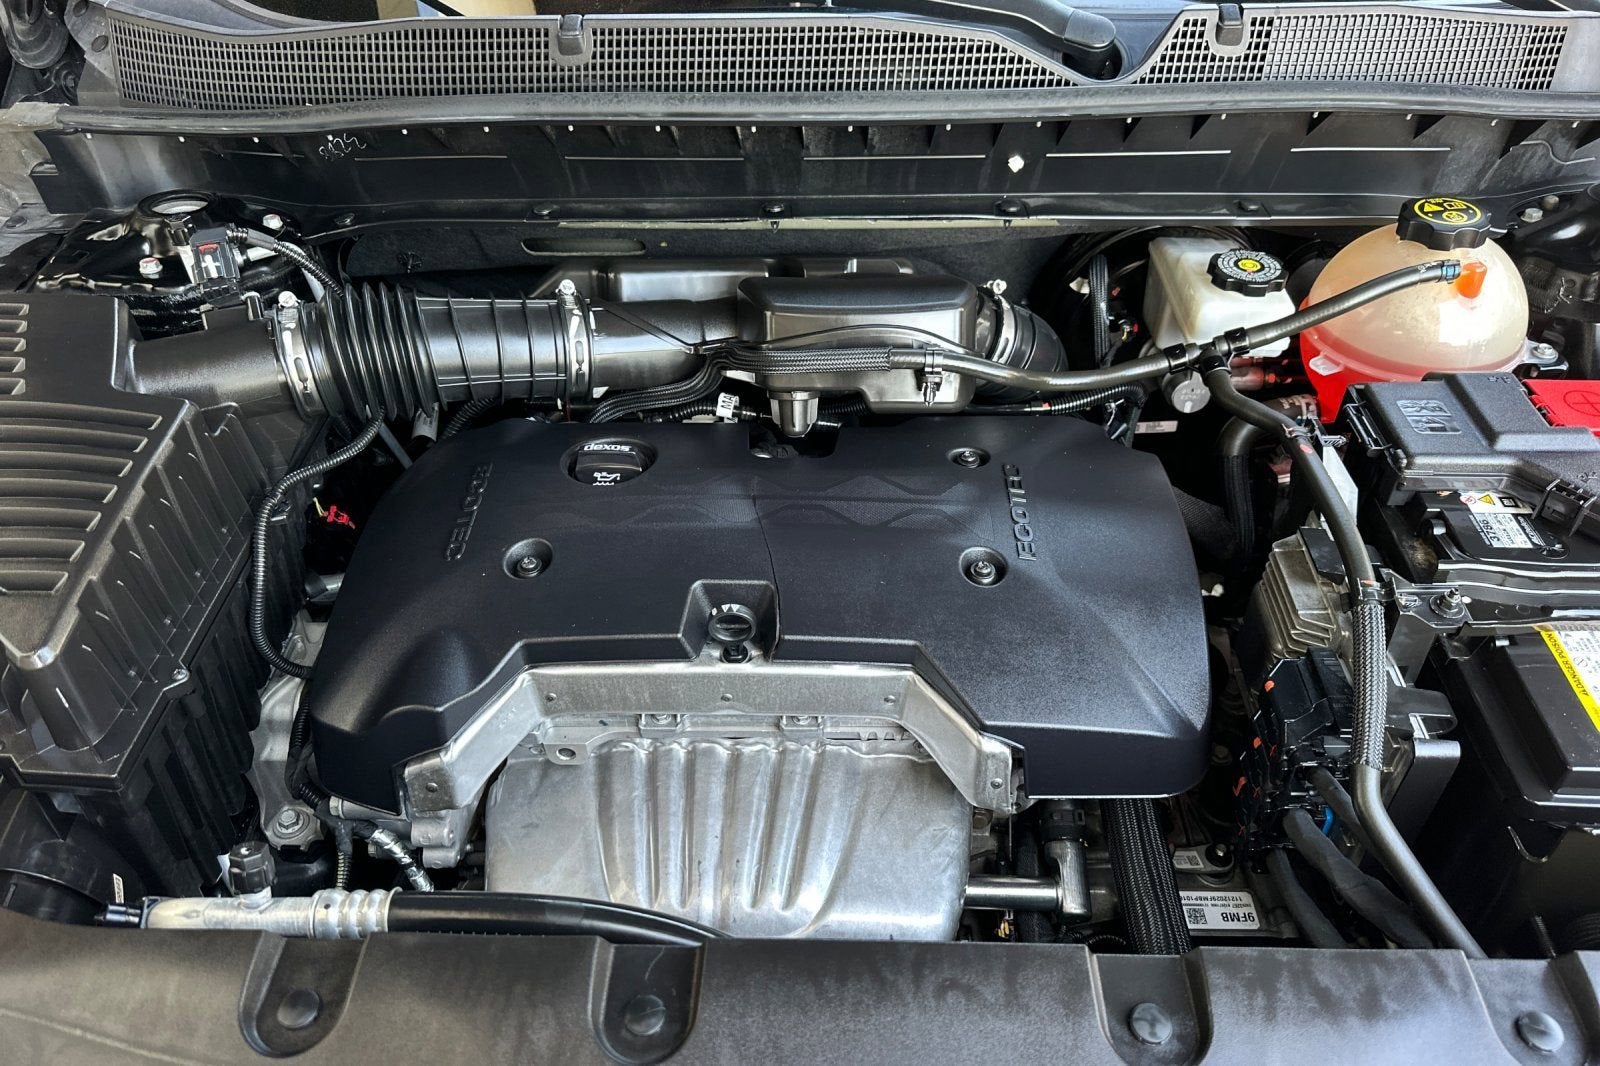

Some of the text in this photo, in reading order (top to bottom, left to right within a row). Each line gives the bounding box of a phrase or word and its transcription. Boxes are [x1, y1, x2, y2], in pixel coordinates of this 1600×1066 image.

[583, 442, 632, 452] dexos
[443, 462, 494, 562] ECOTEC
[1002, 463, 1037, 562] ECOTEC
[1478, 518, 1501, 543] 3786
[1545, 632, 1566, 661] POISON
[1562, 660, 1584, 689] DANGER
[1220, 911, 1256, 923] 9FMB
